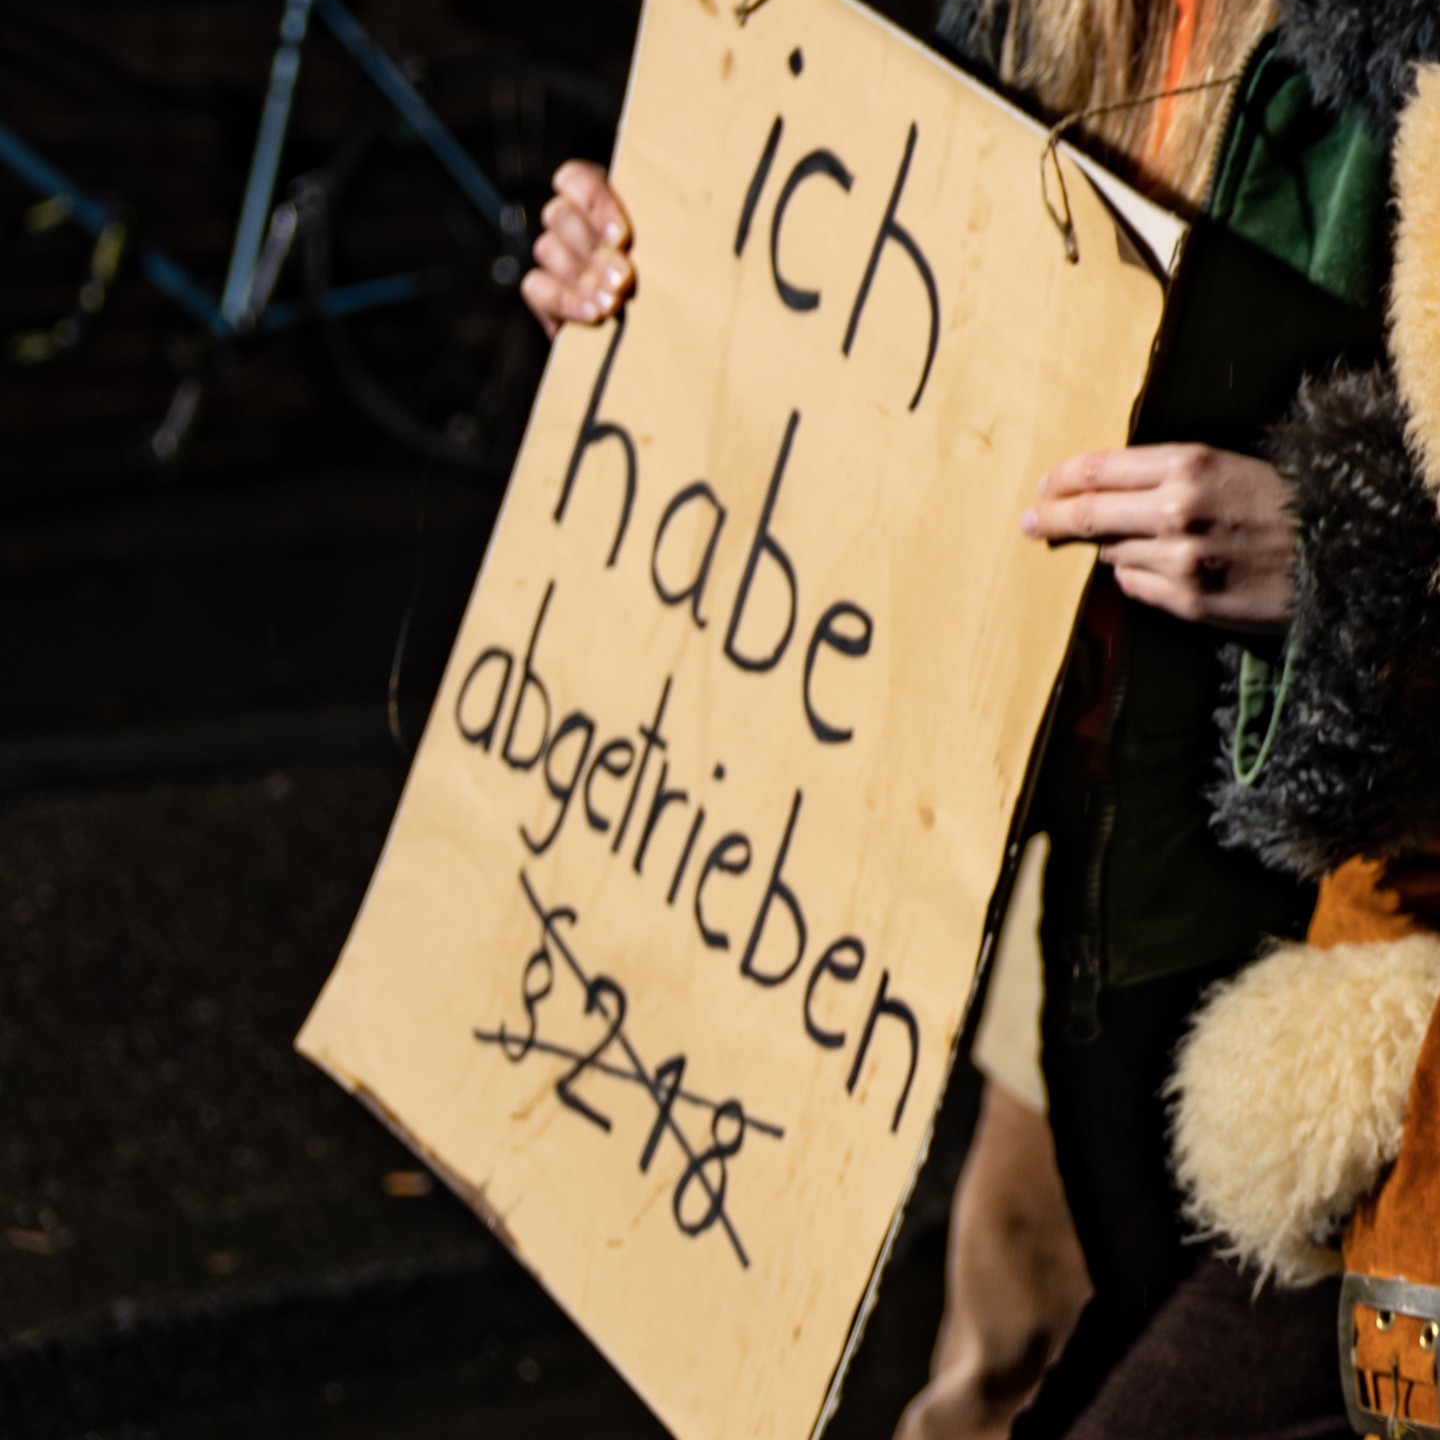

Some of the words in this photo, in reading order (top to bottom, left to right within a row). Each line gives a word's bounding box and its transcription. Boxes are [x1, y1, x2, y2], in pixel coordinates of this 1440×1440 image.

[733, 45, 941, 413] ich
[553, 323, 874, 745] habe
[454, 579, 923, 1132] abgetrieben
